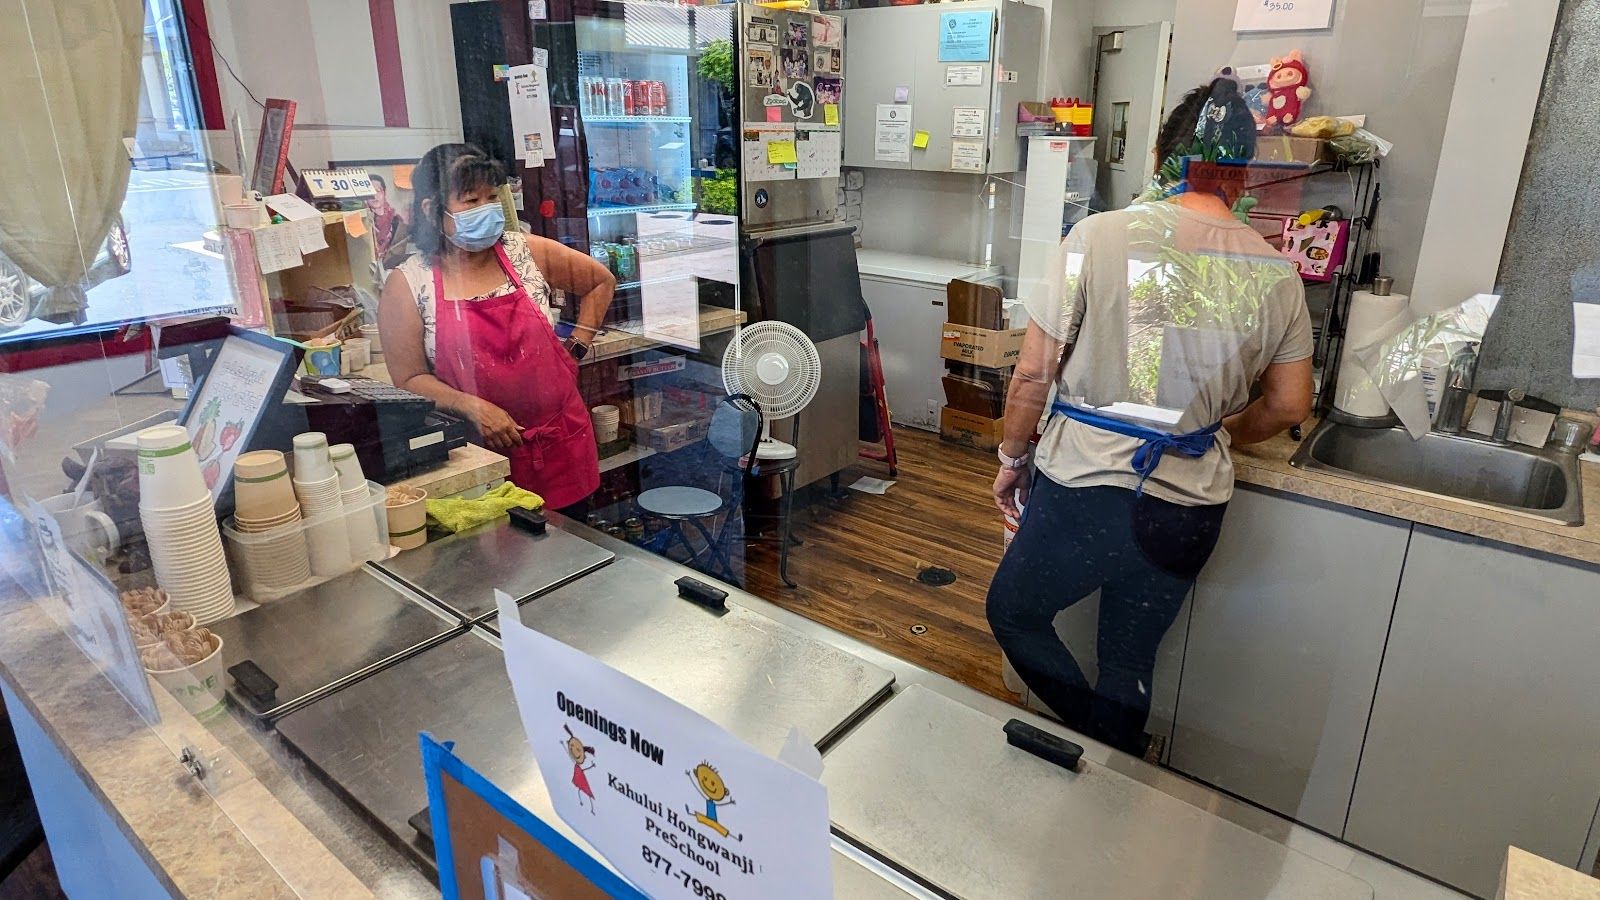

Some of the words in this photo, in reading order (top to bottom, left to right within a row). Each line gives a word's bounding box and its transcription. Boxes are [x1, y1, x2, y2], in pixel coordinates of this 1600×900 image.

[1263, 0, 1294, 11] $35.00
[312, 178, 323, 189] T
[330, 179, 349, 191] 30
[351, 178, 371, 188] Sep
[953, 341, 984, 352] EVAPORATED
[556, 690, 627, 745] Openings
[630, 728, 665, 766] Now
[607, 772, 663, 818] Kahului
[666, 807, 755, 875] Hongwanji
[645, 816, 721, 876] PreSchool
